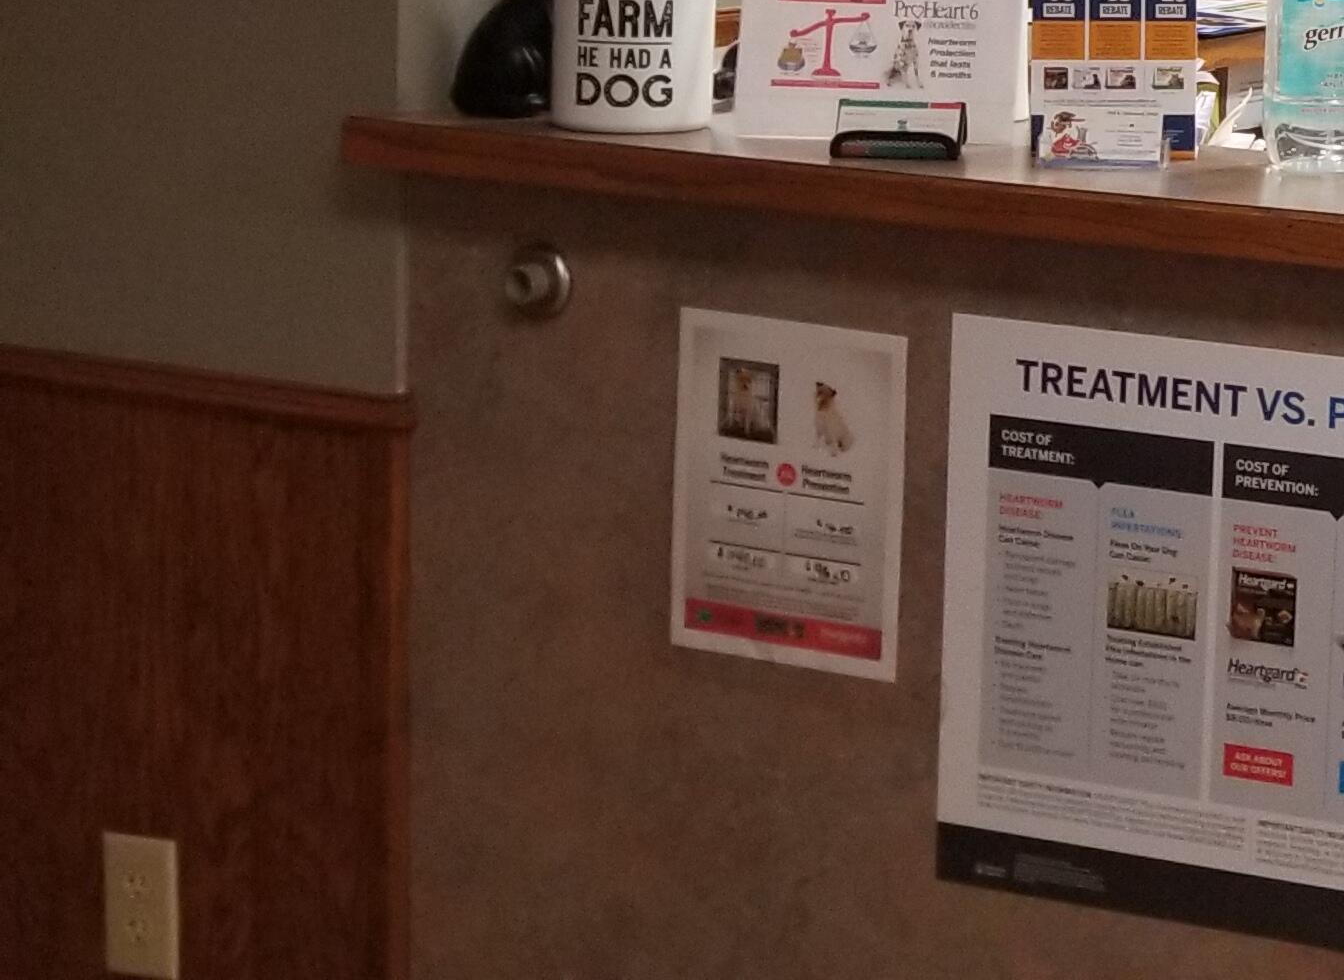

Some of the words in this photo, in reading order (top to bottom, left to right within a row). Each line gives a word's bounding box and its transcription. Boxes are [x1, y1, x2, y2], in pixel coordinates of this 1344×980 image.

[1045, 5, 1073, 15] REBATE
[1102, 5, 1129, 15] REBATE
[1158, 5, 1184, 15] REBATE
[577, 45, 599, 69] HE
[609, 45, 649, 70] HAD
[657, 46, 672, 70] A
[575, 73, 675, 109] DOG
[1015, 358, 1248, 418] TREATMENT
[1256, 387, 1316, 427] VS.
[1001, 429, 1032, 444] COST
[1036, 433, 1054, 447] OF
[1001, 445, 1076, 465] TREATMENT:
[1235, 459, 1270, 474] COST
[1272, 462, 1290, 476] OF
[1234, 475, 1320, 497] PREVENTION:
[1233, 524, 1278, 538] PREVENT
[1233, 536, 1297, 554] HEARTWORM
[1227, 658, 1296, 682] Heartgard
